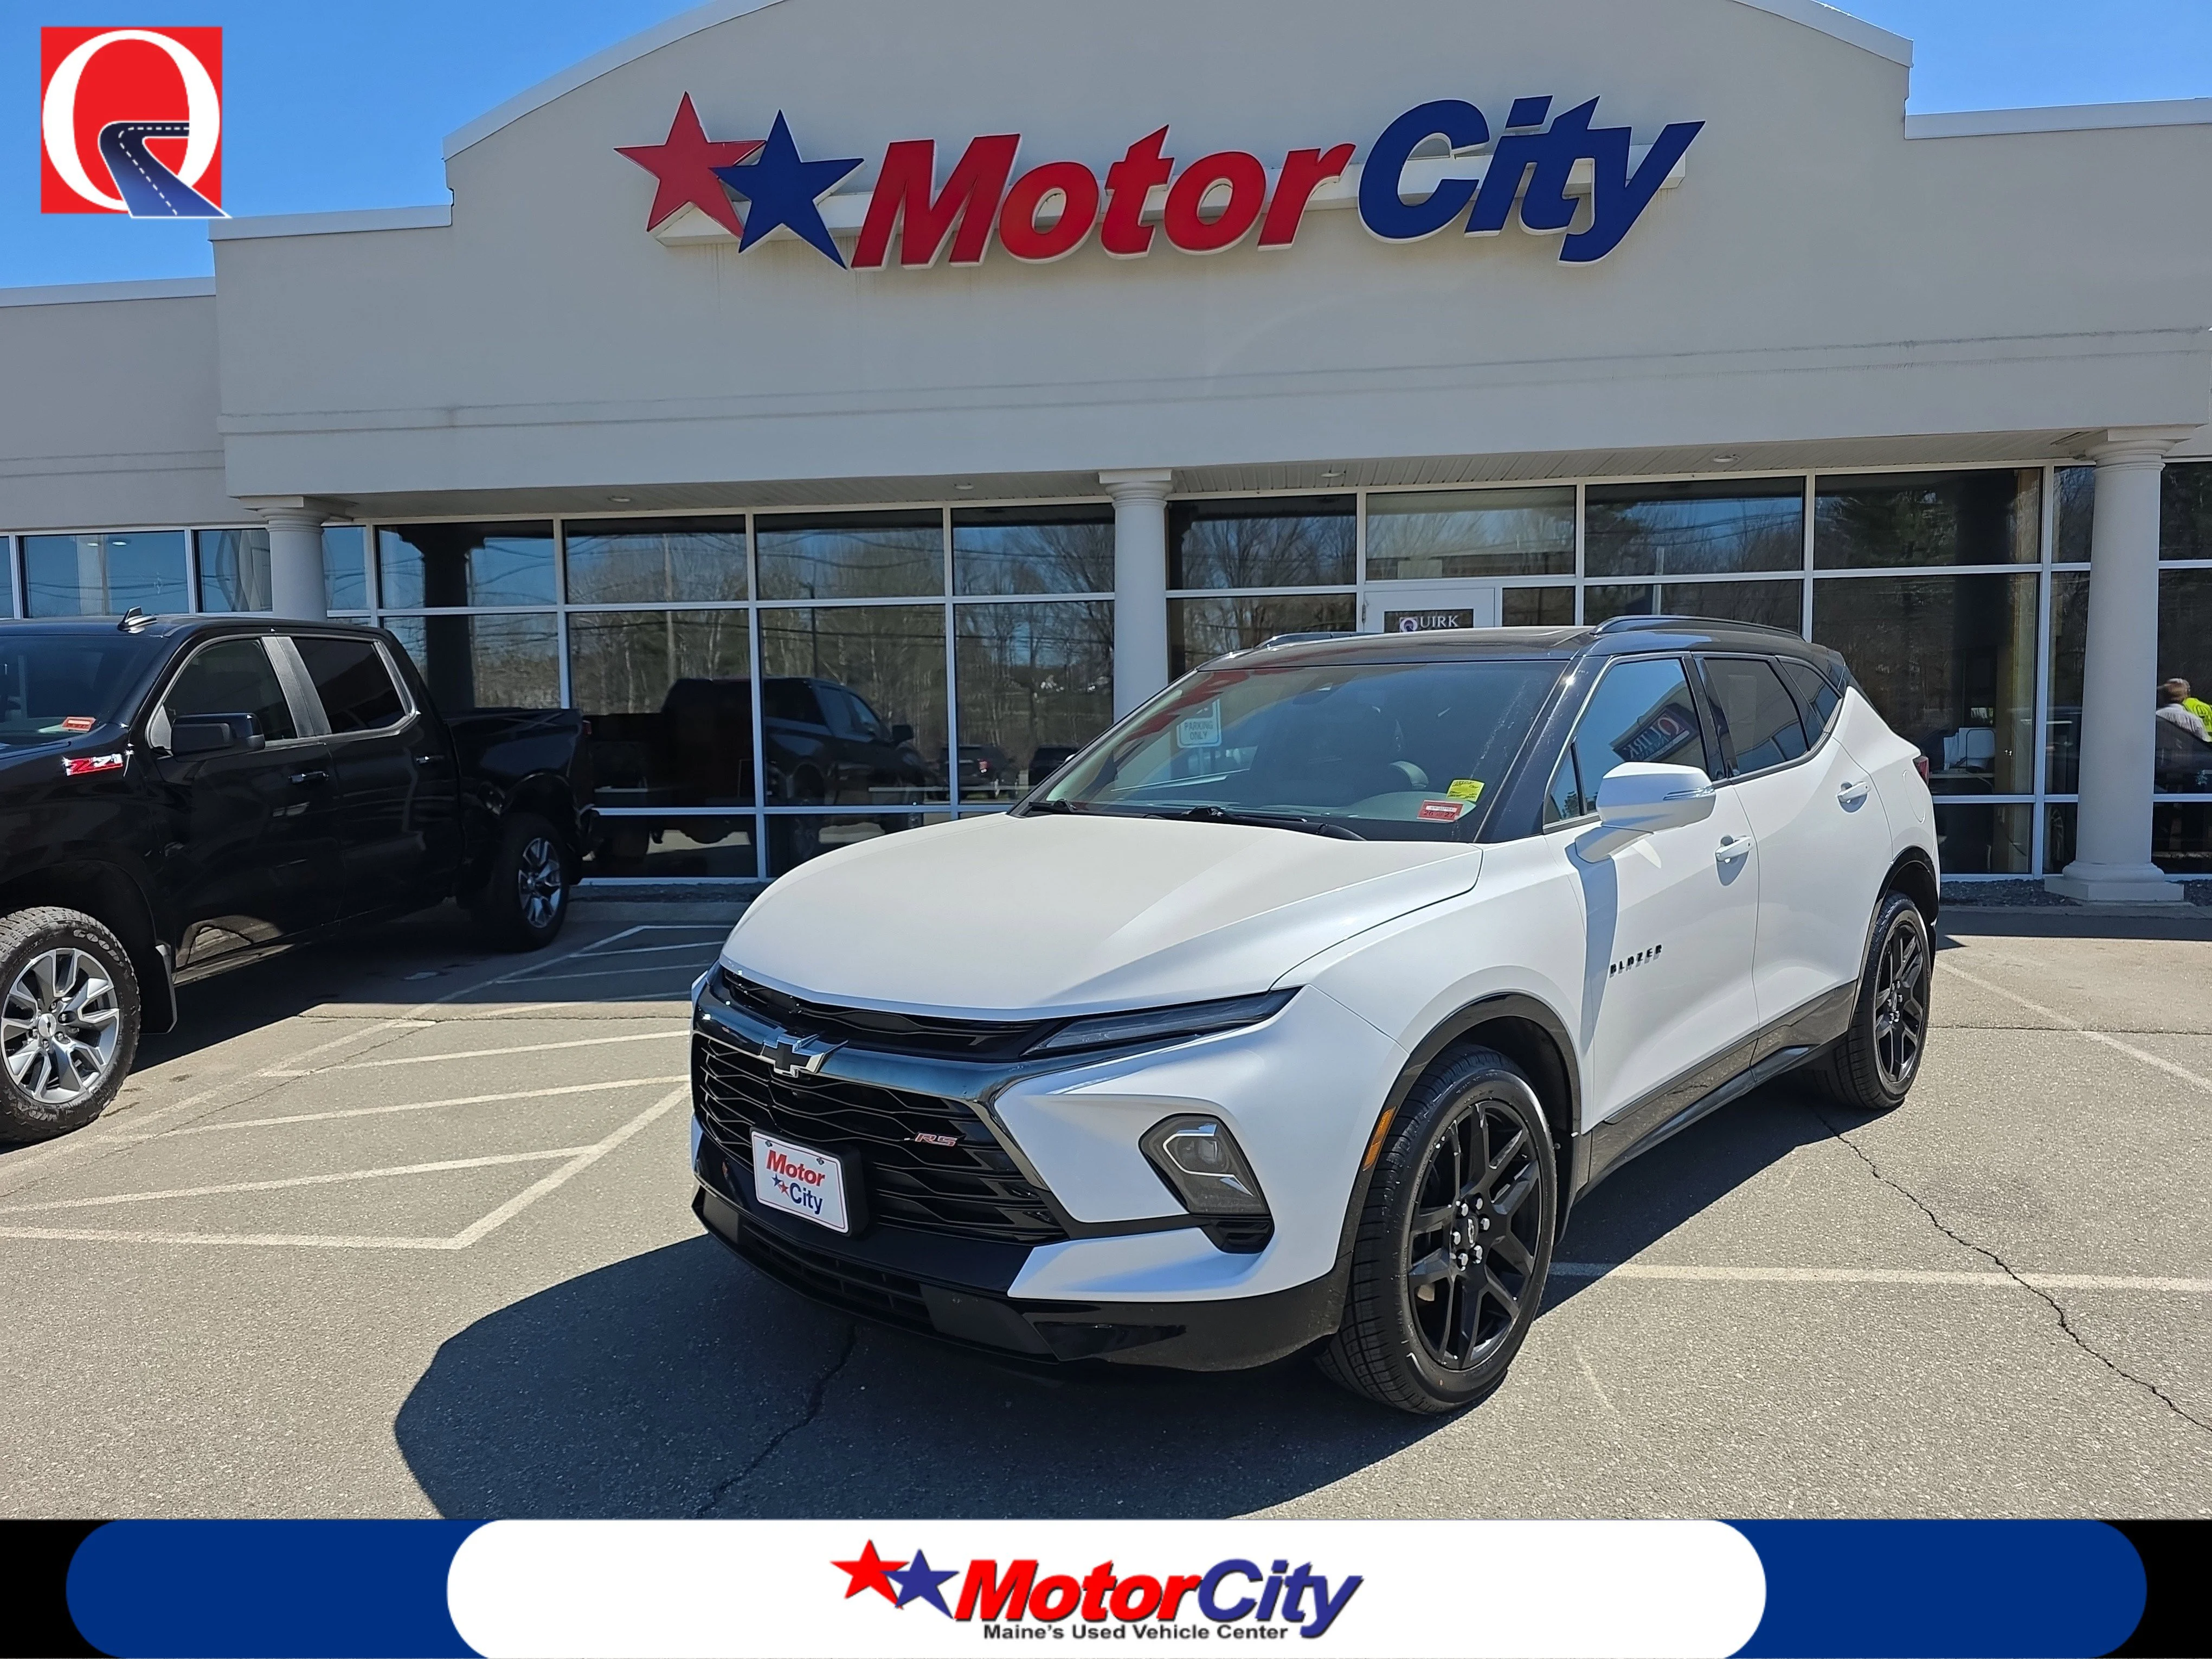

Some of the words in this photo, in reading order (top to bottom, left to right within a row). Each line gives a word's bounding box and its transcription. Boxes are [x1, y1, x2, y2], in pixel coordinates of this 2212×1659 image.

[1399, 614, 1459, 632] QUIRK
[1184, 722, 1213, 731] PARKING
[1189, 732, 1208, 740] ONLY
[1610, 944, 1662, 974] BLAZER
[915, 1133, 958, 1147] RS
[766, 1149, 826, 1187] Motor
[789, 1182, 823, 1215] City
